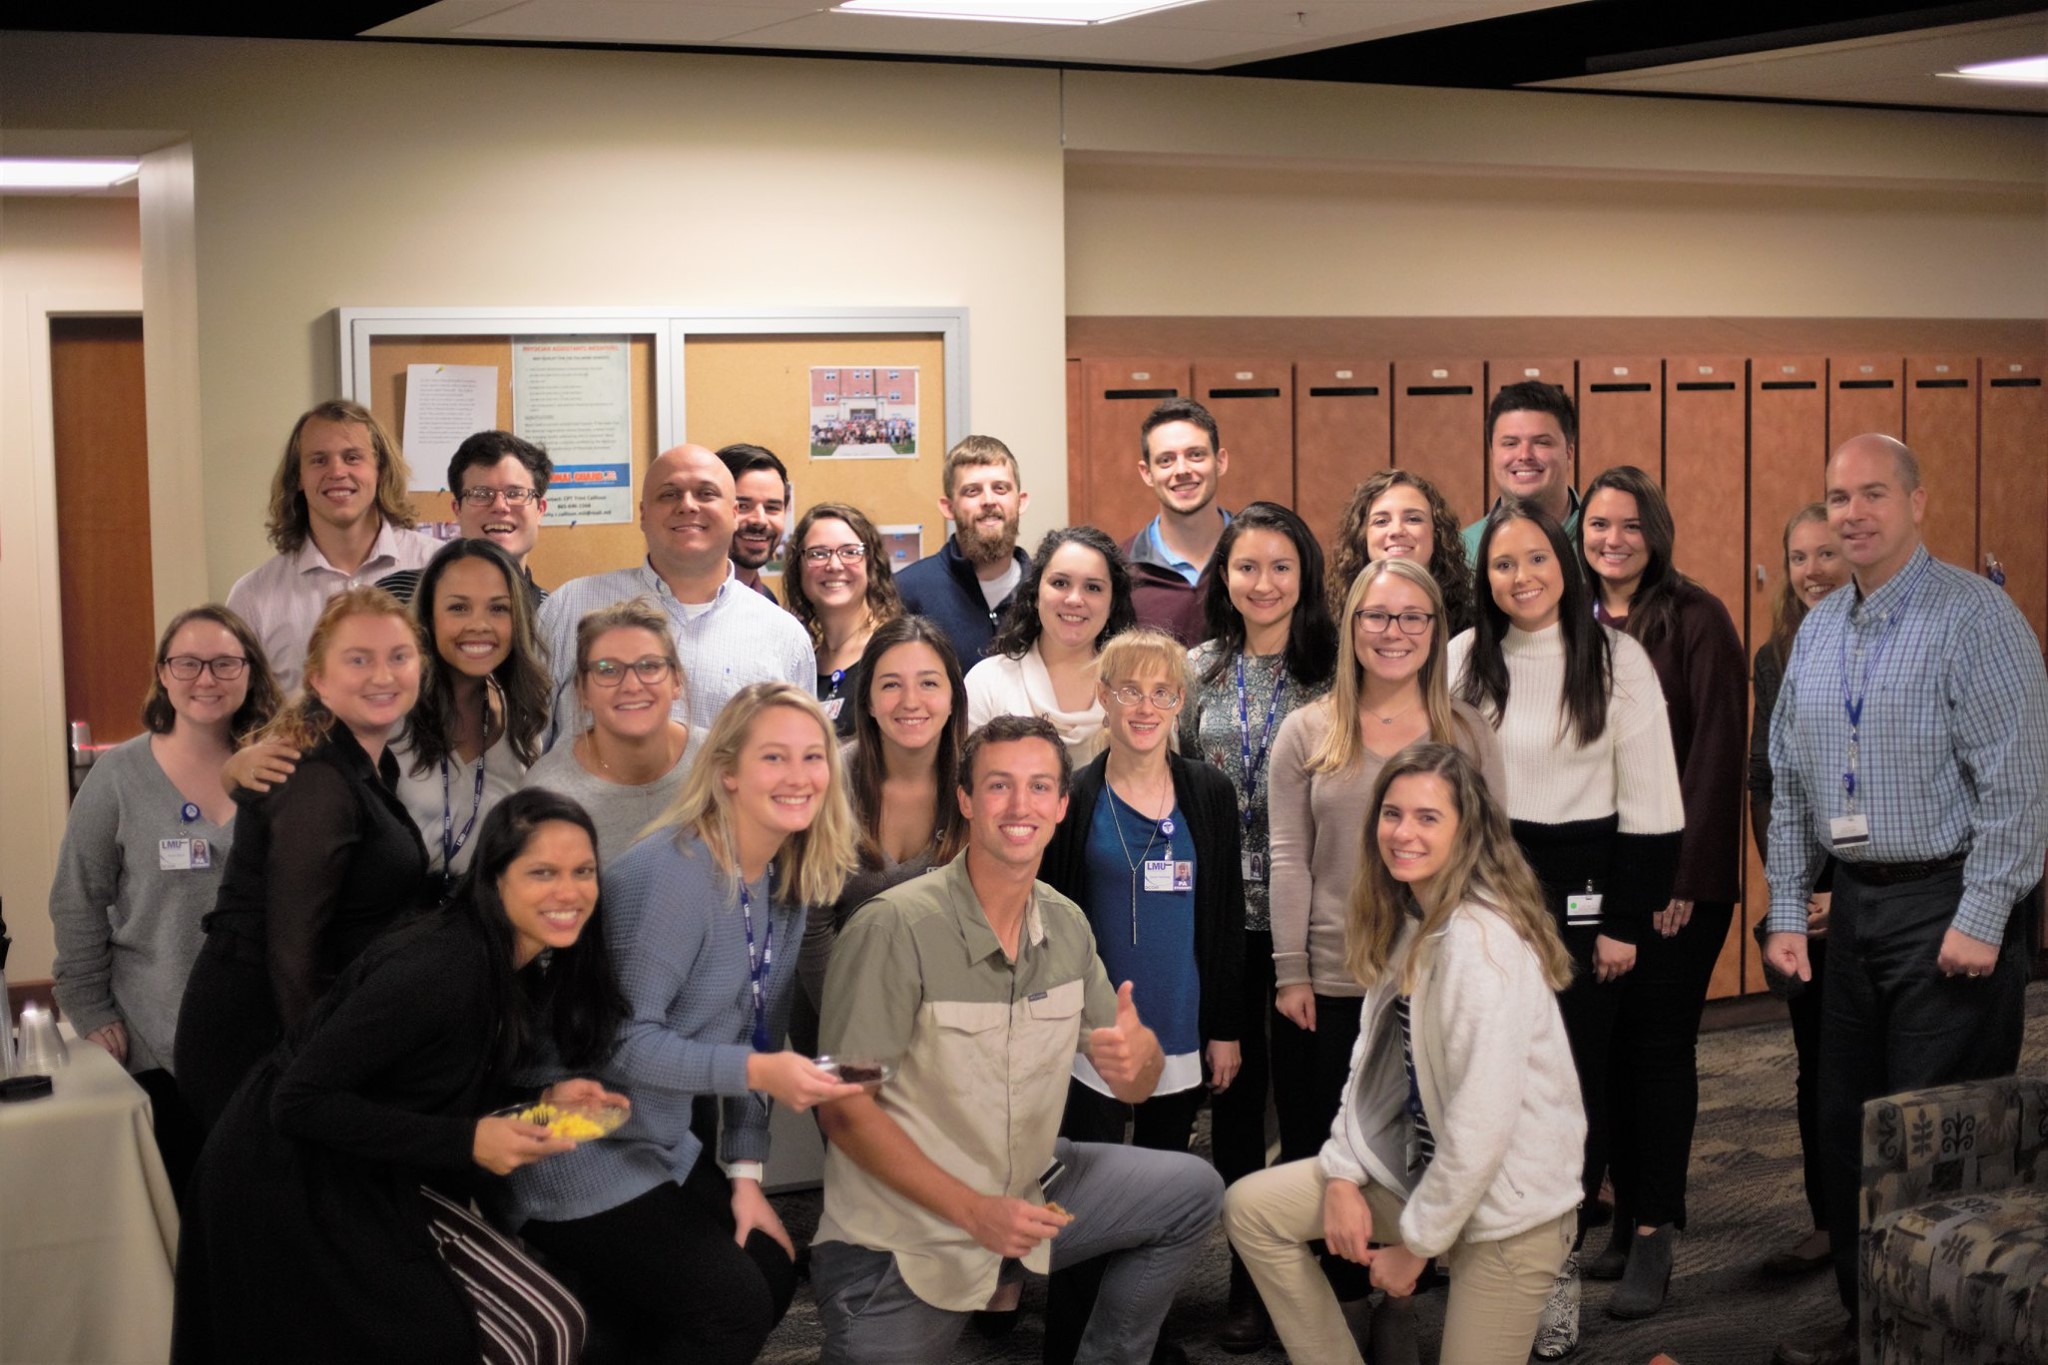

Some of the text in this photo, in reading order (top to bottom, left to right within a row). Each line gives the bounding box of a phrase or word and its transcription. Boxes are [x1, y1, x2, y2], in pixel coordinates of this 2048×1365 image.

[456, 833, 466, 847] LMU
[162, 841, 182, 849] LMU
[1147, 862, 1166, 871] LMU
